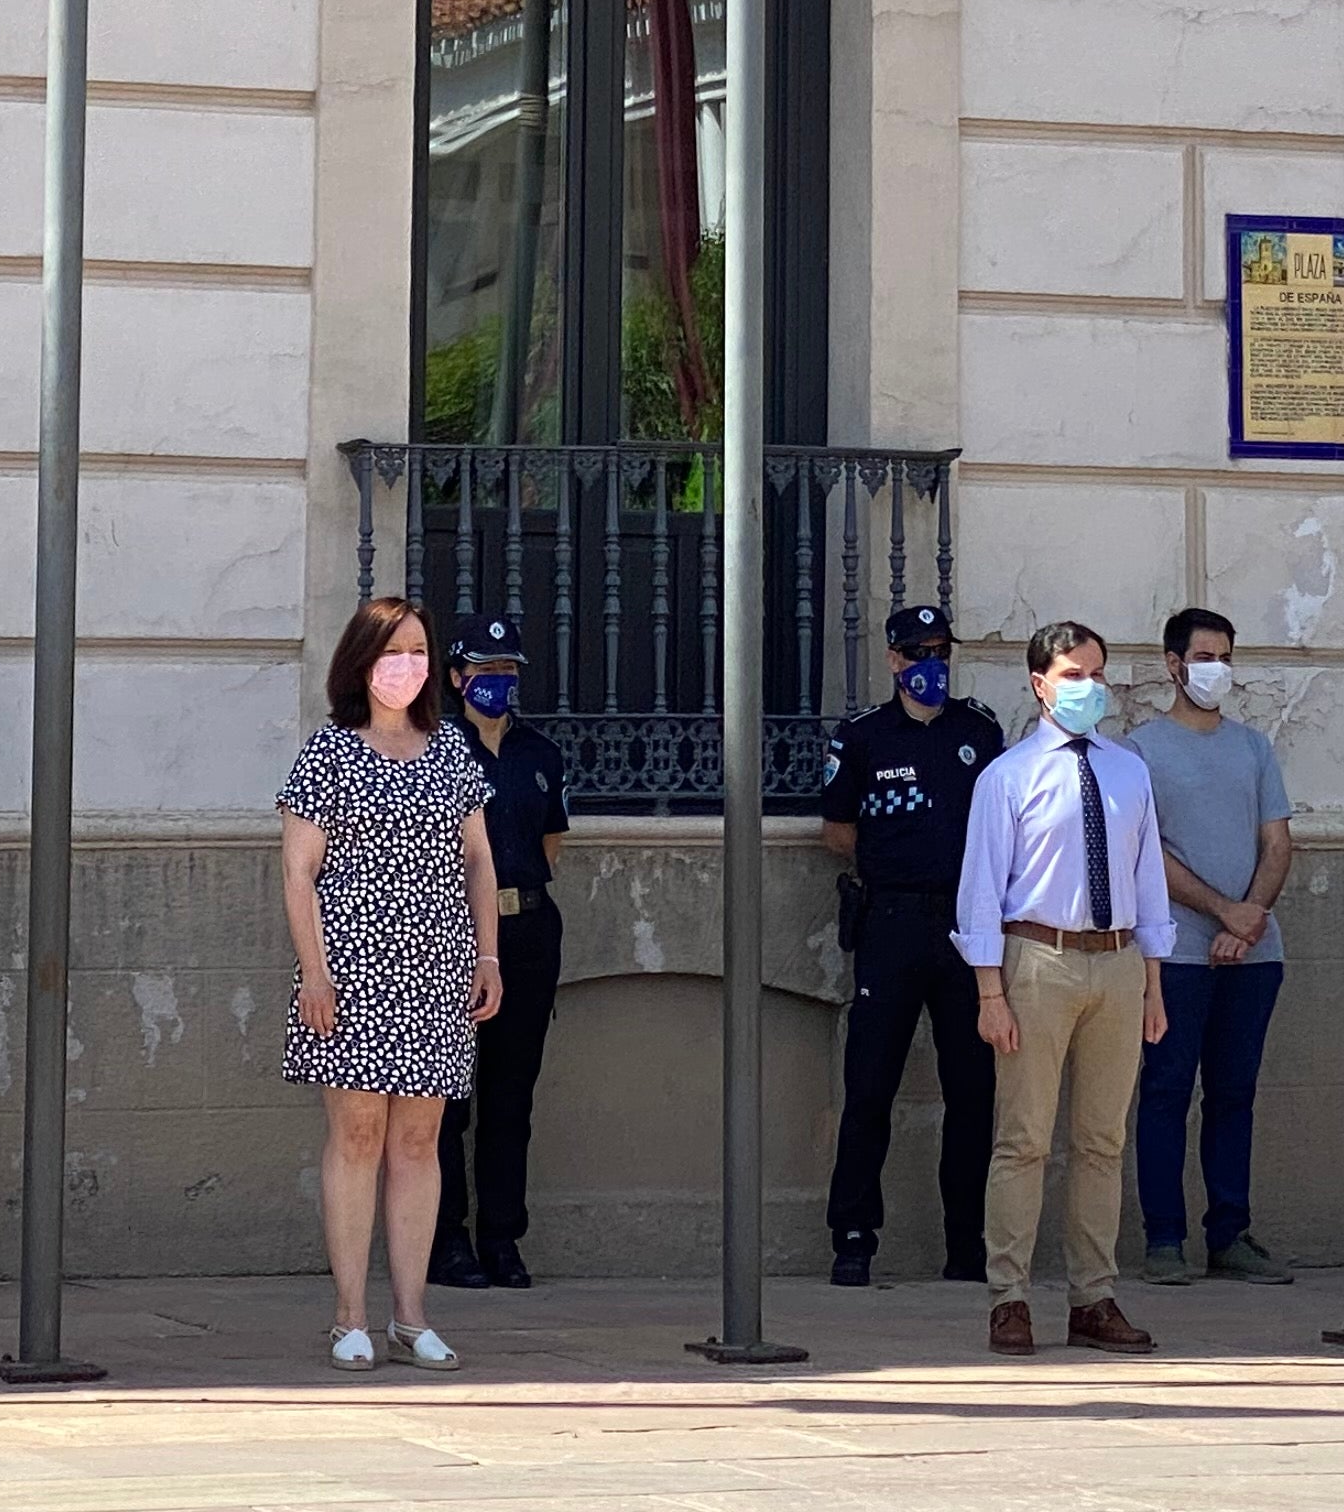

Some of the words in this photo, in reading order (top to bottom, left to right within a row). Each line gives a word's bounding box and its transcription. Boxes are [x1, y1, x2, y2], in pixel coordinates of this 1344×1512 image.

[1293, 252, 1327, 280] PLAZA
[1279, 291, 1295, 303] DE
[1297, 291, 1342, 304] ESPAÑA
[876, 767, 916, 781] POLICIA
